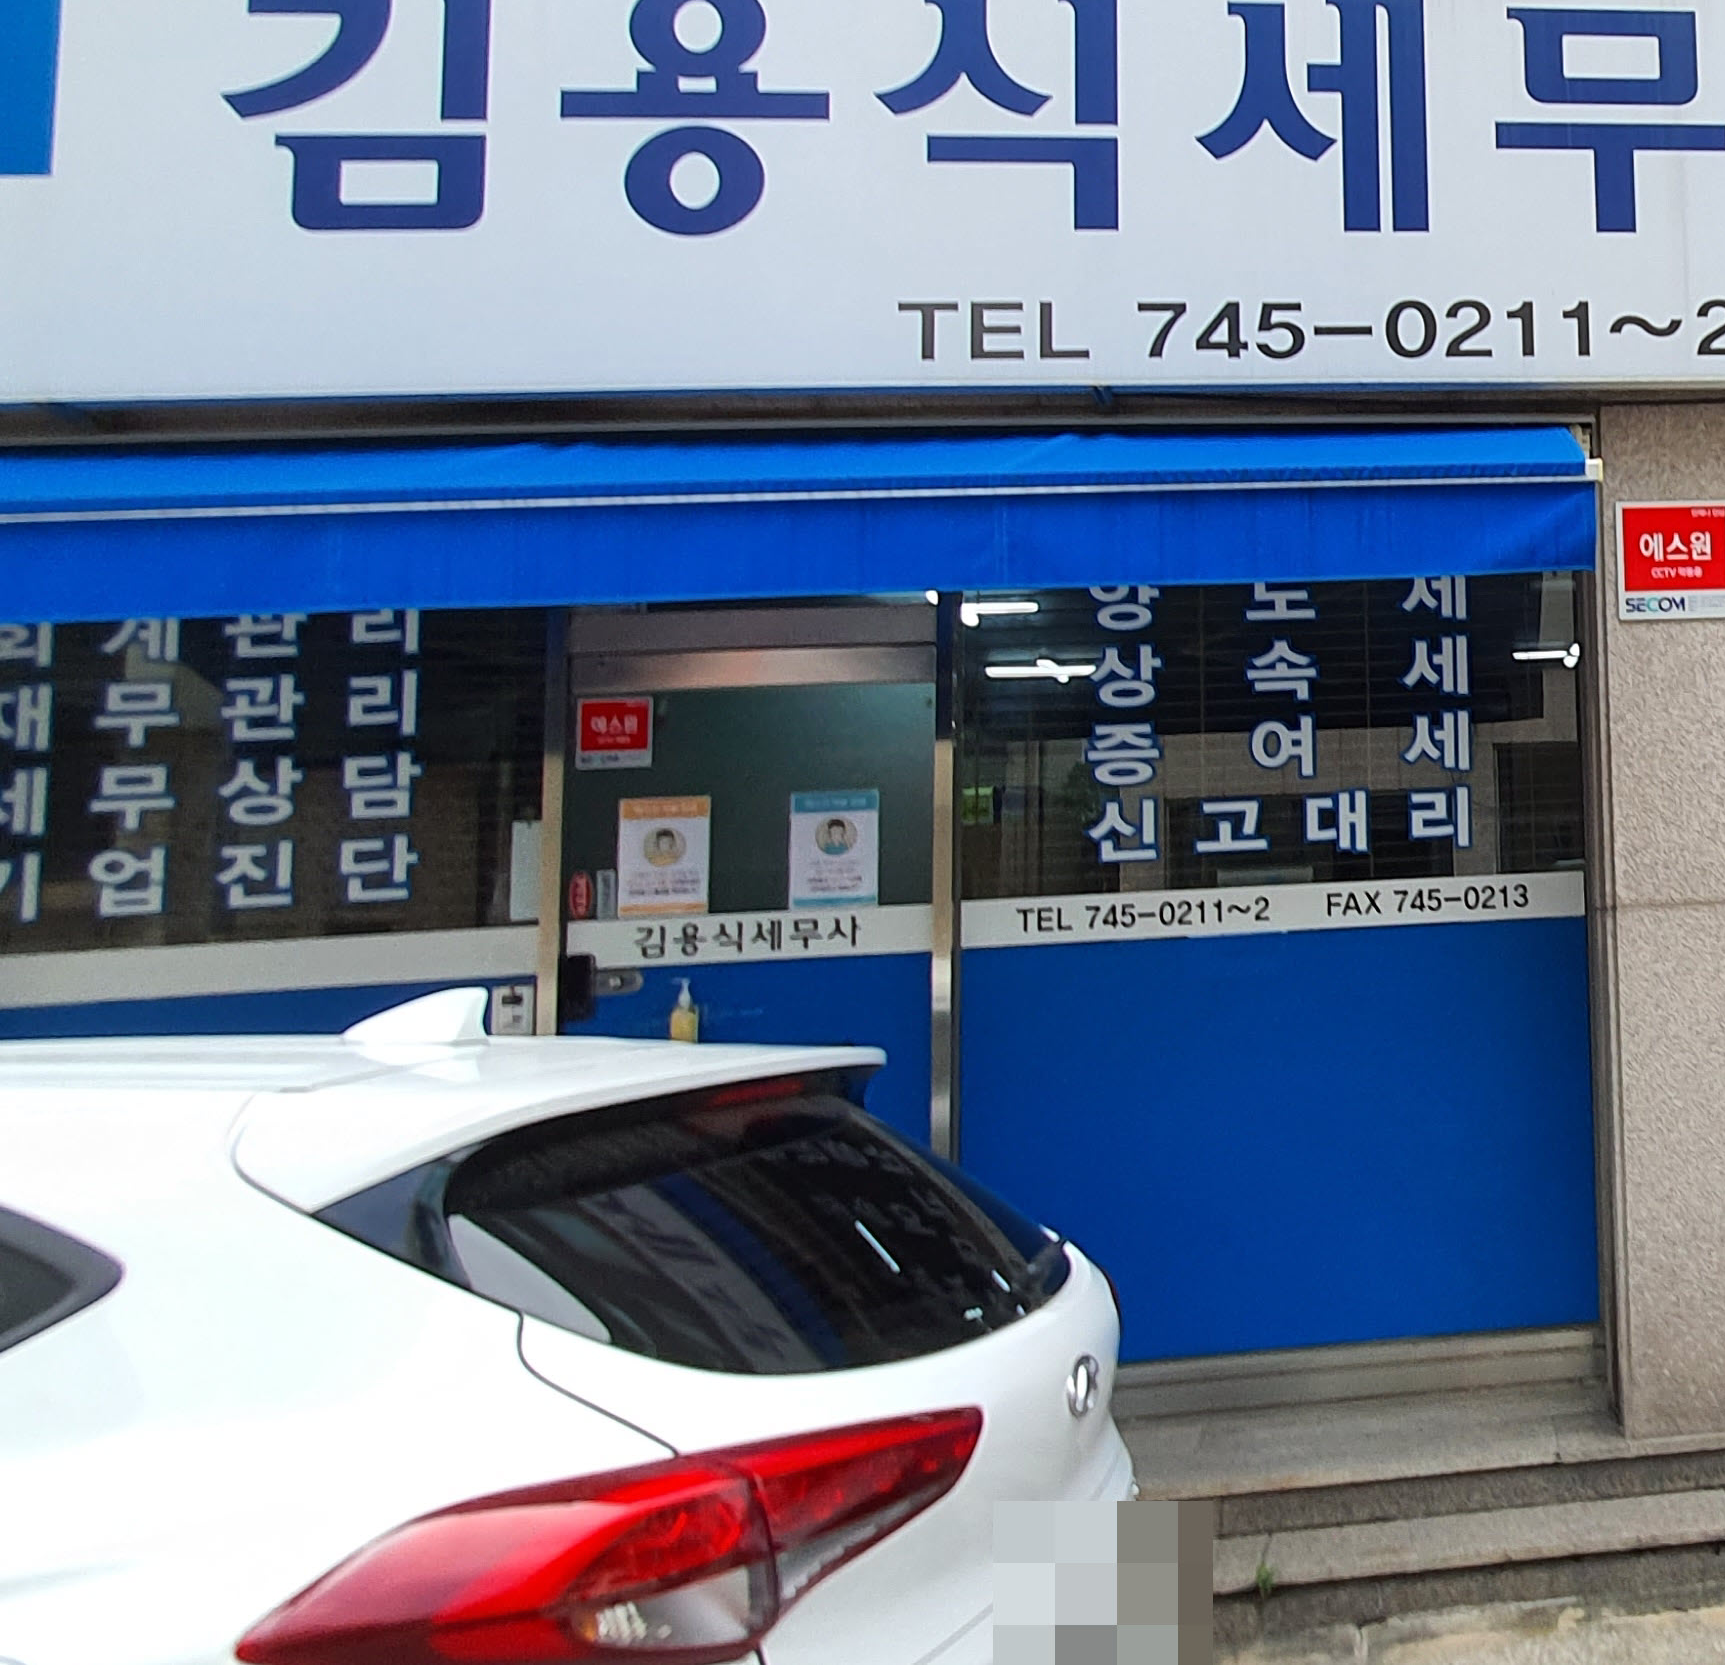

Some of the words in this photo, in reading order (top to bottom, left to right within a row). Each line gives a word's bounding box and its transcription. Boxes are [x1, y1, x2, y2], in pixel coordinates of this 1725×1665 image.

[897, 300, 1090, 361] TEL
[1639, 531, 1712, 562] 에스원
[1625, 597, 1686, 613] SECOM
[1017, 906, 1071, 933] TEL
[1085, 897, 1270, 929] 745-0211~2
[1326, 891, 1381, 916] FAX
[1393, 884, 1530, 913] 745-0213
[635, 915, 860, 958] 김용식세무사
